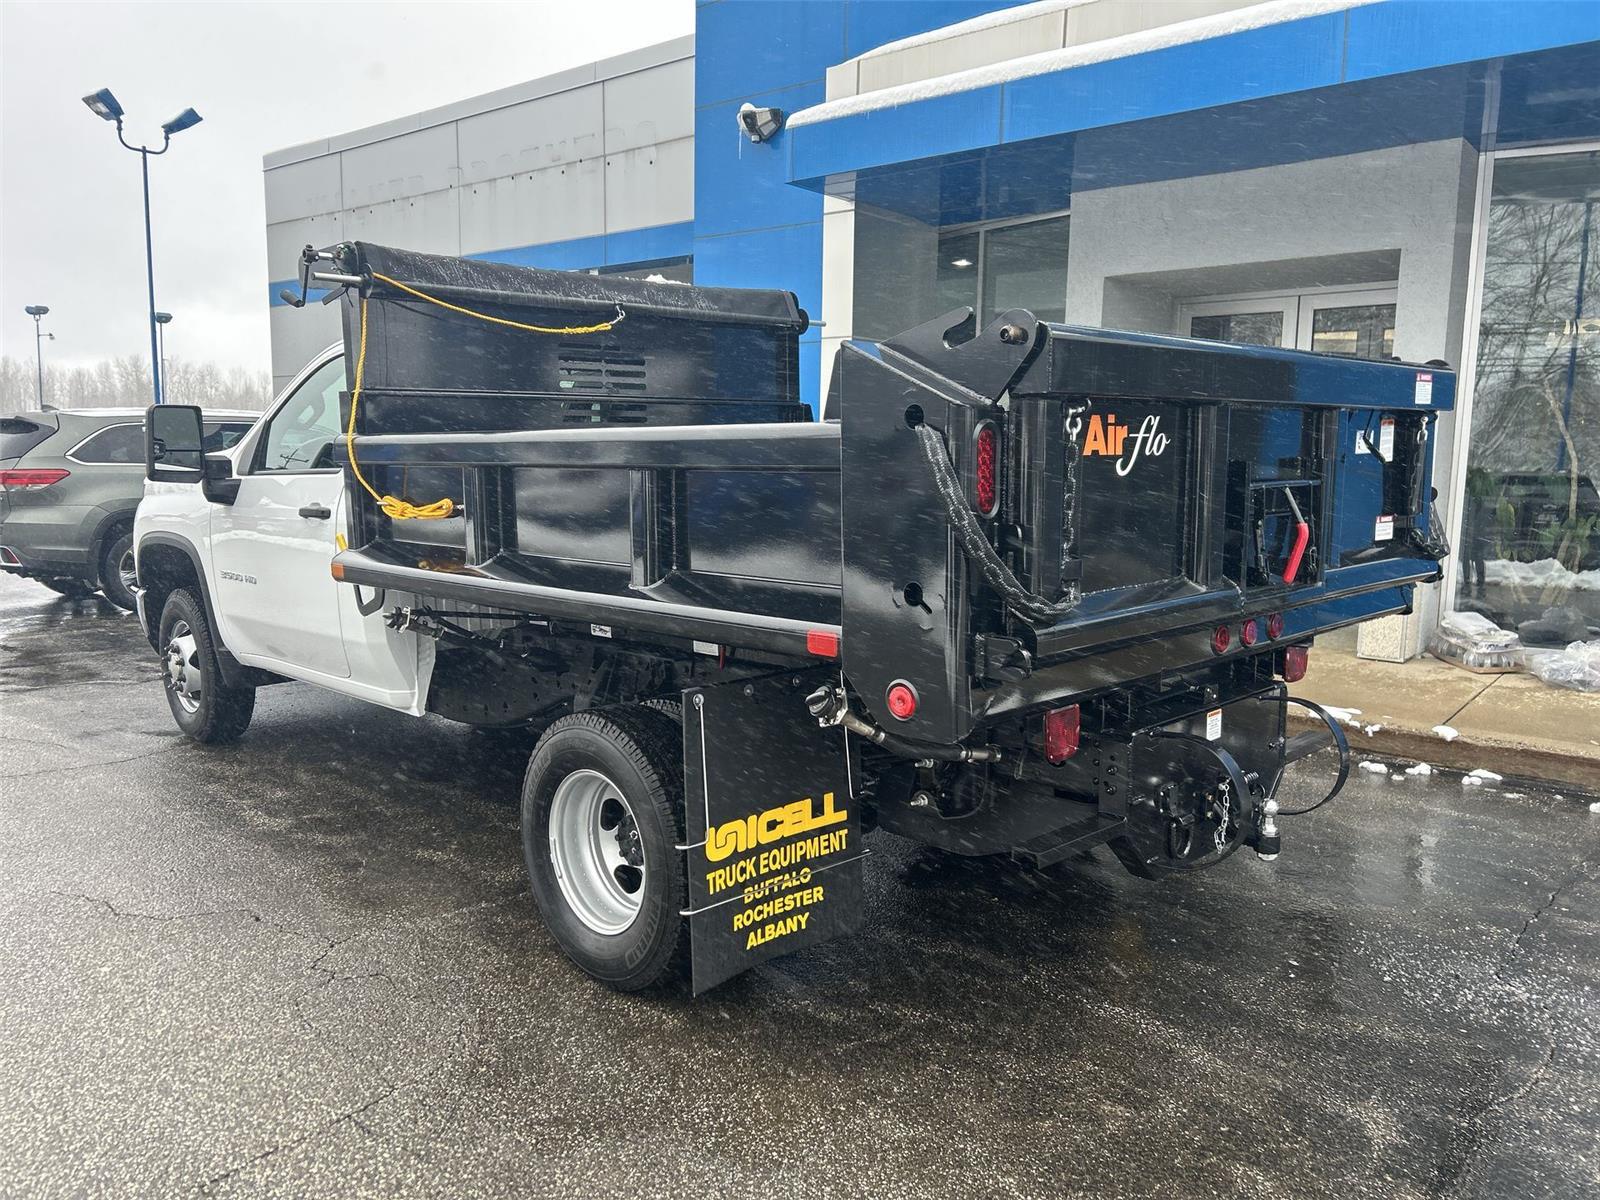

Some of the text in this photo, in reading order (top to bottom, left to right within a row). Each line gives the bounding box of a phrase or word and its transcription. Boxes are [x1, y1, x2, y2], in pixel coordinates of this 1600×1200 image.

[220, 570, 257, 585] 3500 HD
[705, 792, 848, 862] UNICELL
[706, 829, 848, 896] TRUCK EQUIPMENT
[744, 867, 812, 904] BUFFALO
[733, 886, 824, 931] ROCHESTER
[746, 912, 810, 950] ALBANY
